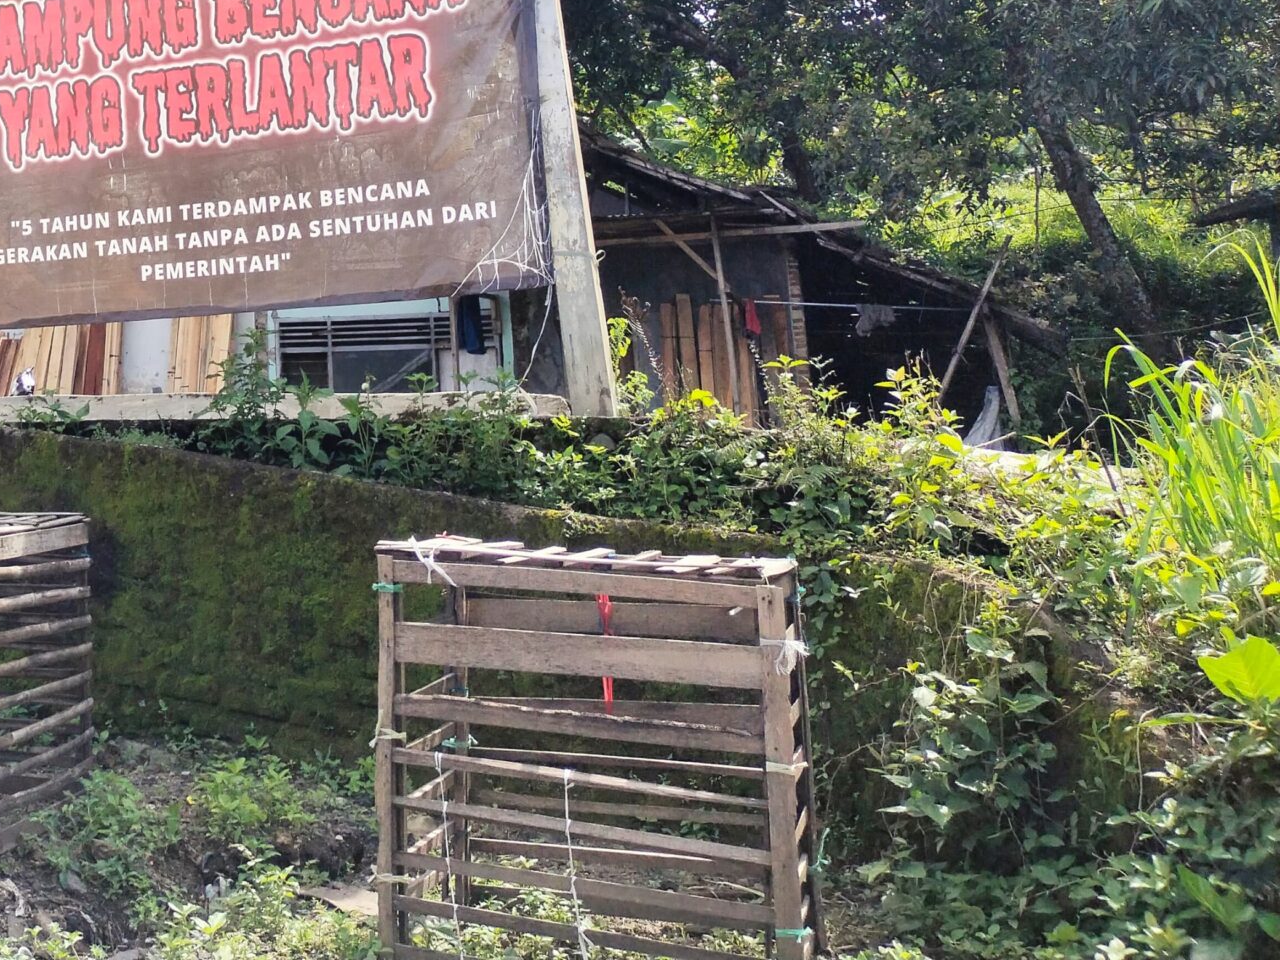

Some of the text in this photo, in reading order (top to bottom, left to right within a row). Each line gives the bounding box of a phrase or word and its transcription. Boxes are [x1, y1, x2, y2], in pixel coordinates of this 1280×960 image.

[131, 33, 433, 155] TERLANTAR
[10, 178, 431, 236] "5 TAHUN KAMI TERDAMPAK BENCANA
[94, 234, 168, 257] TANAH
[174, 227, 249, 250] TANPA
[255, 222, 302, 243] ADA
[308, 208, 434, 238] SENTUHAN
[441, 200, 497, 225] DARI
[140, 252, 291, 282] PEMERINTAH"
